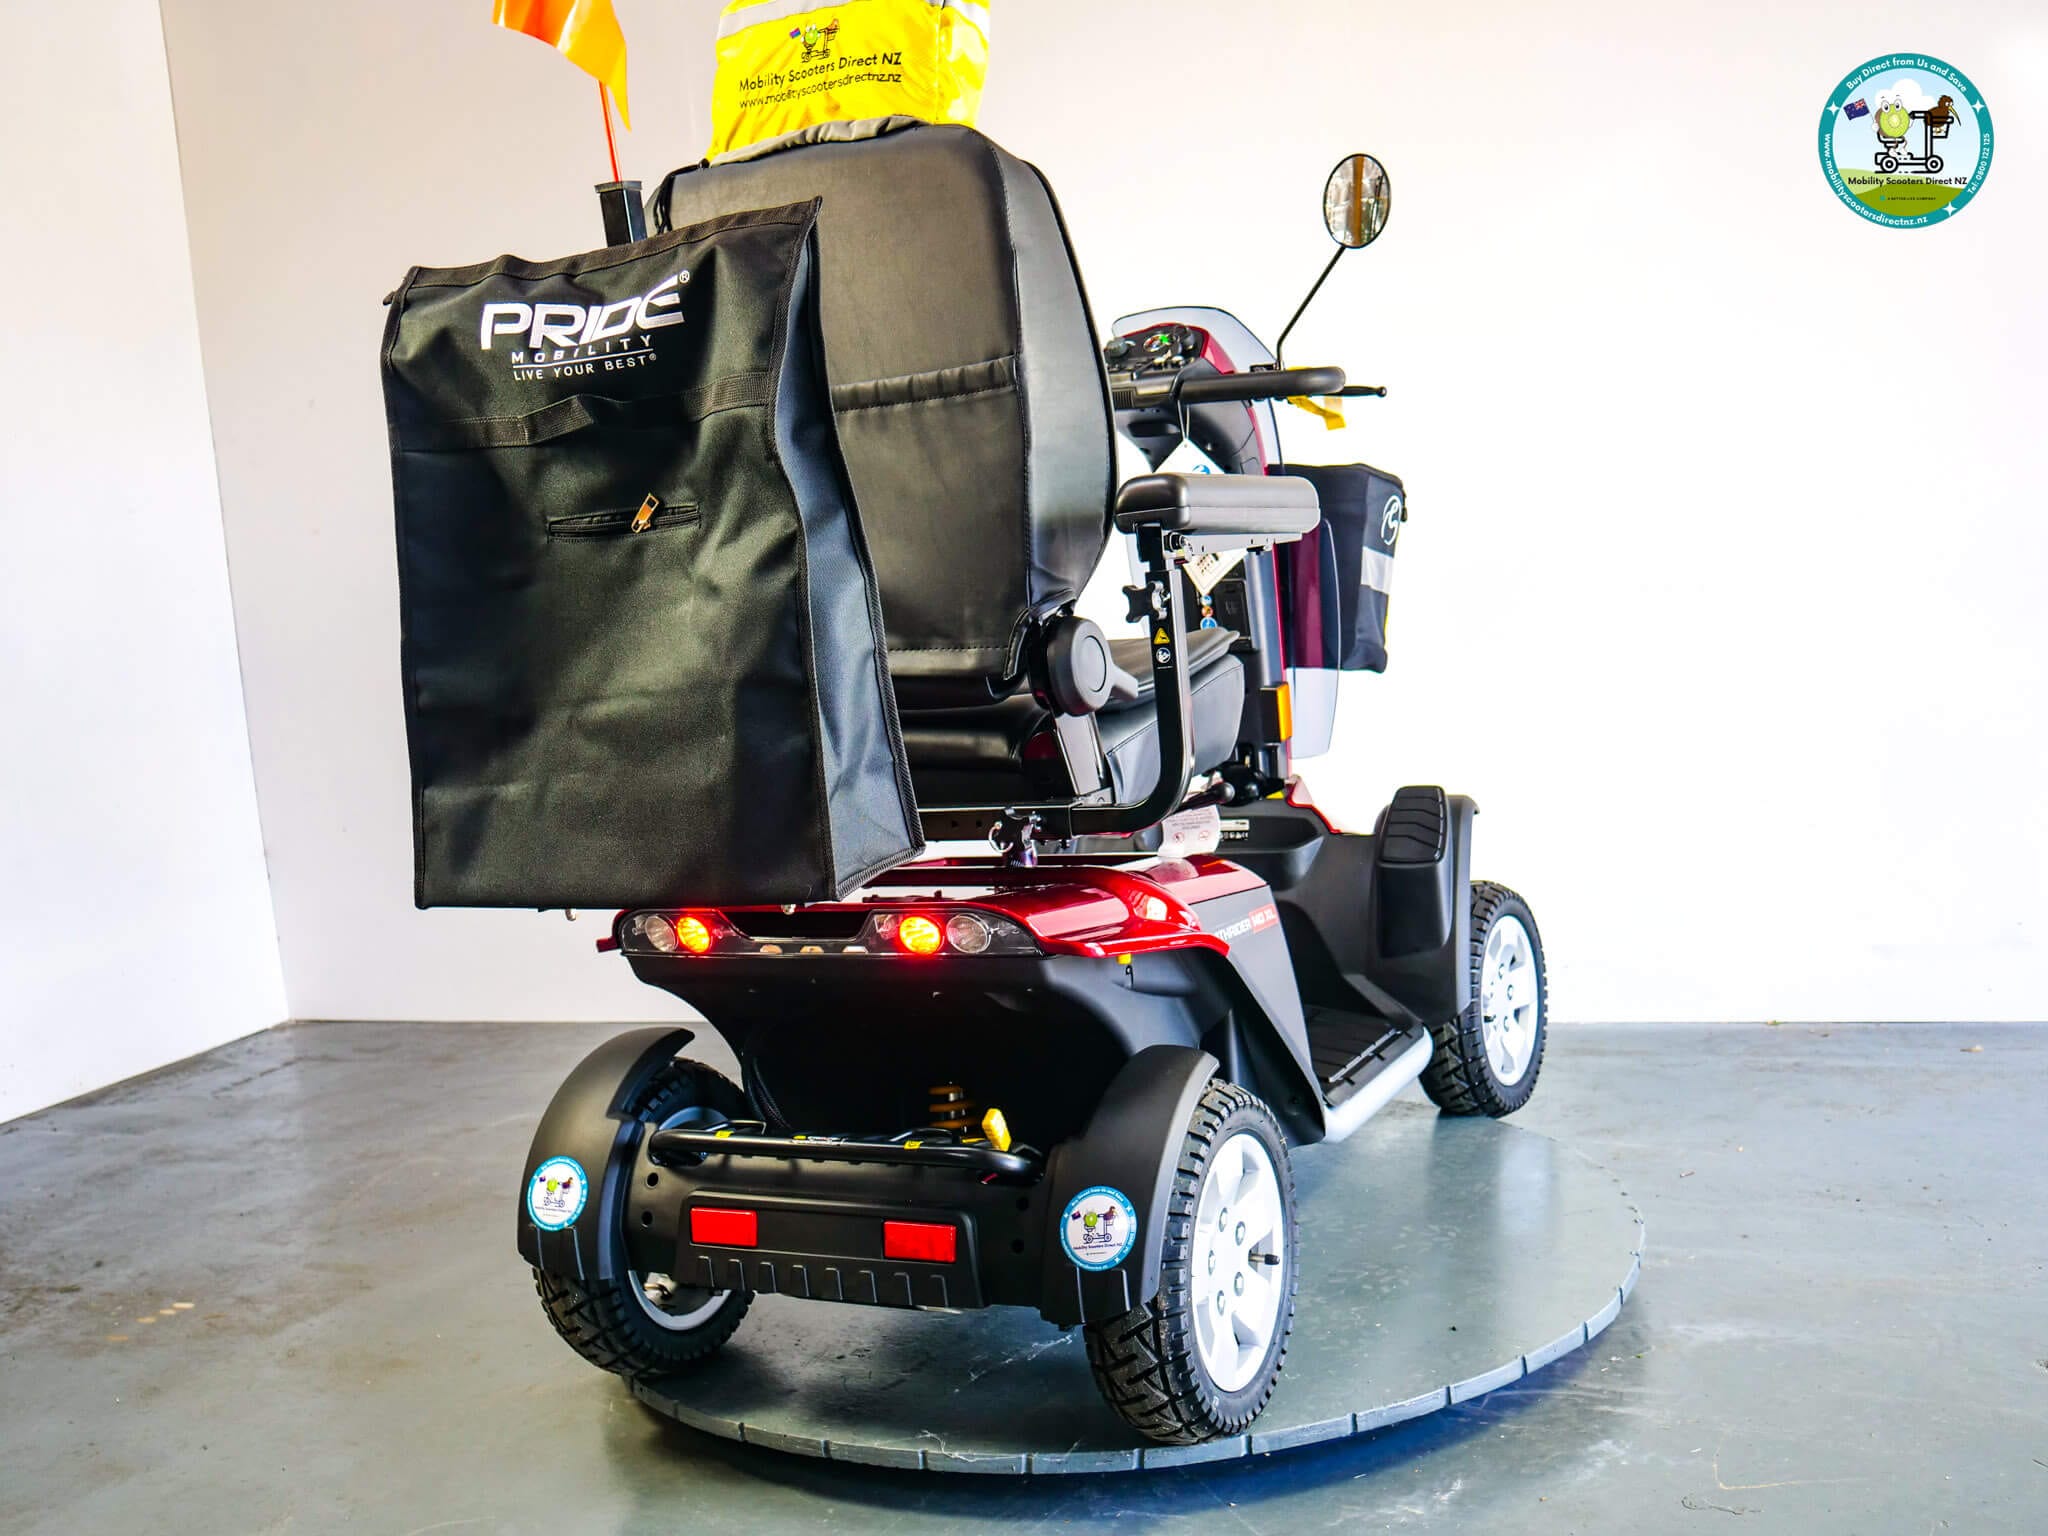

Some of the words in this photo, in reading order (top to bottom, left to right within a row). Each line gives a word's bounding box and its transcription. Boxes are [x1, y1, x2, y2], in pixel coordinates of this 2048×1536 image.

[739, 72, 785, 93] Mobility
[788, 62, 836, 81] Scooters
[839, 55, 878, 70] Direct
[882, 52, 902, 65] NZ
[512, 335, 653, 364] MOBILITY
[513, 369, 544, 381] LIVE
[554, 362, 595, 378] YOUR
